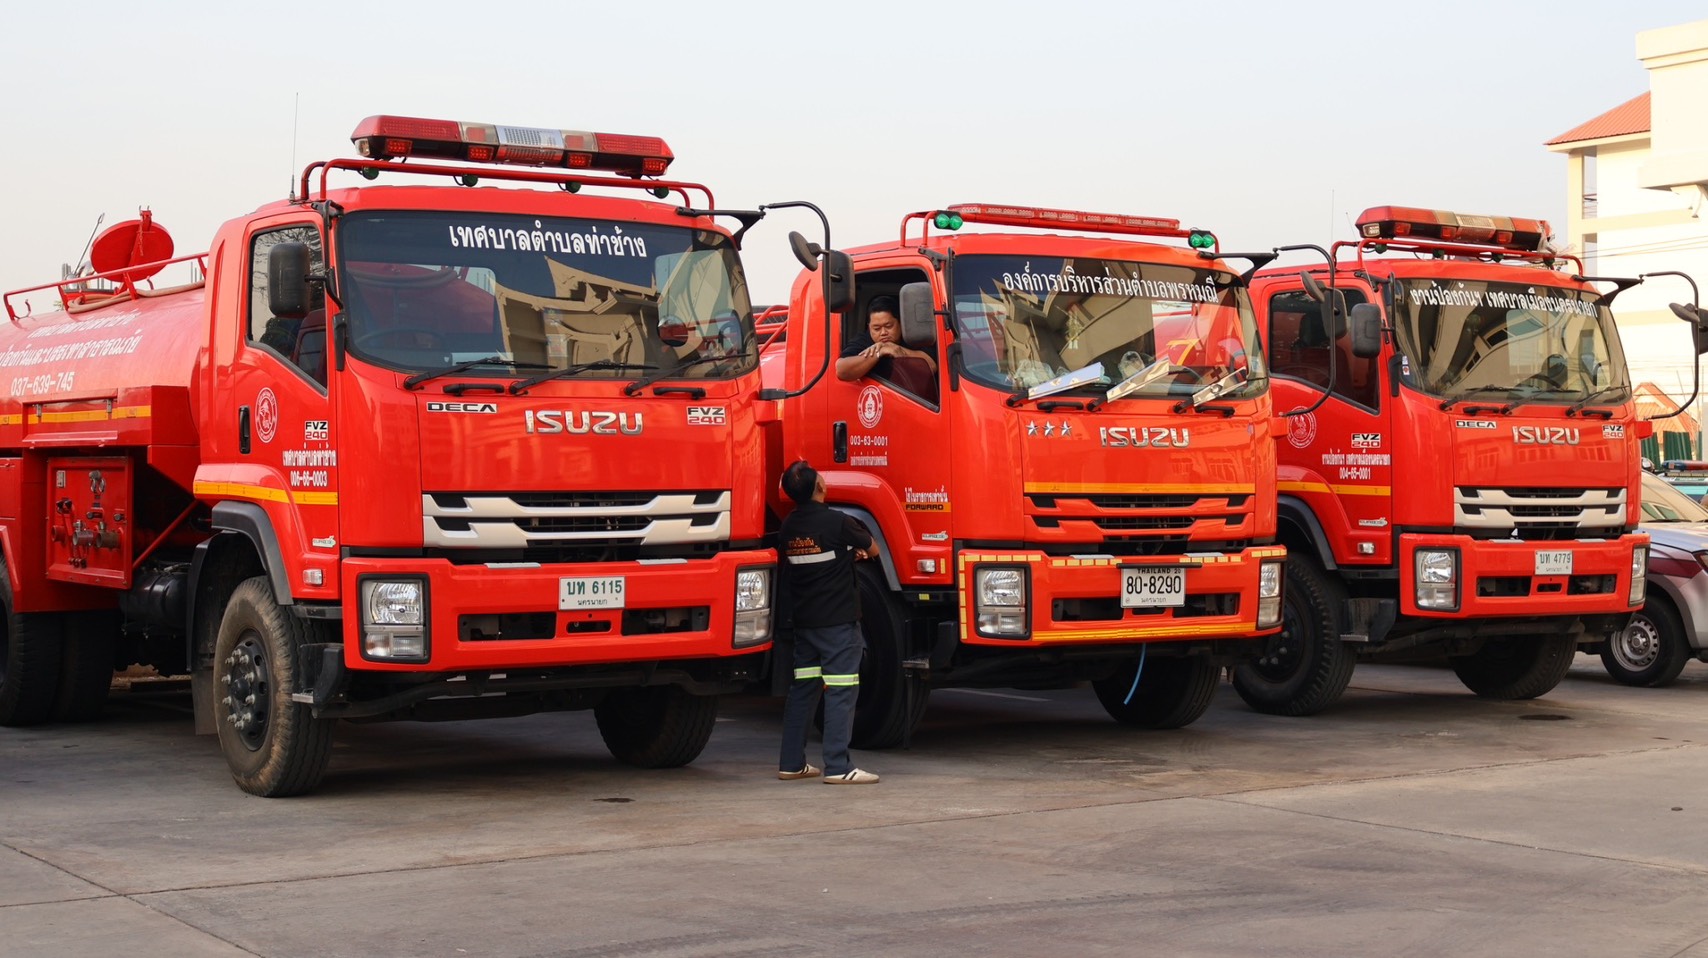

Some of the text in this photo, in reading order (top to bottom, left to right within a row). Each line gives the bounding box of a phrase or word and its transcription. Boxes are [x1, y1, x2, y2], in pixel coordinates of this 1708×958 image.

[449, 219, 647, 257] เทศบาลตำบลท่าช้าง
[1002, 261, 1219, 304] องค์การบริหารส่วนตำบลพรหมณี
[1485, 287, 1598, 318] เทศบาลเมืองนครนายก
[11, 371, 75, 397] 037-639-745
[428, 402, 496, 413] DECA
[687, 406, 725, 416] FVZ
[305, 421, 327, 430] FVZ
[524, 409, 643, 435] ISUZU
[688, 415, 725, 425] 240
[1456, 420, 1496, 429] DECA
[1602, 424, 1623, 432] FVZ
[305, 431, 328, 440] 240
[850, 435, 888, 446] 003-63-0001
[1099, 426, 1190, 448] ISUZU
[1352, 433, 1380, 441] FVZ
[1511, 425, 1580, 445] ISUZU
[1602, 431, 1624, 439] 240
[905, 503, 944, 511] FORWARD
[1554, 553, 1571, 564] 4779
[566, 580, 622, 595] บท 6115
[1126, 575, 1182, 594] 80-8290
